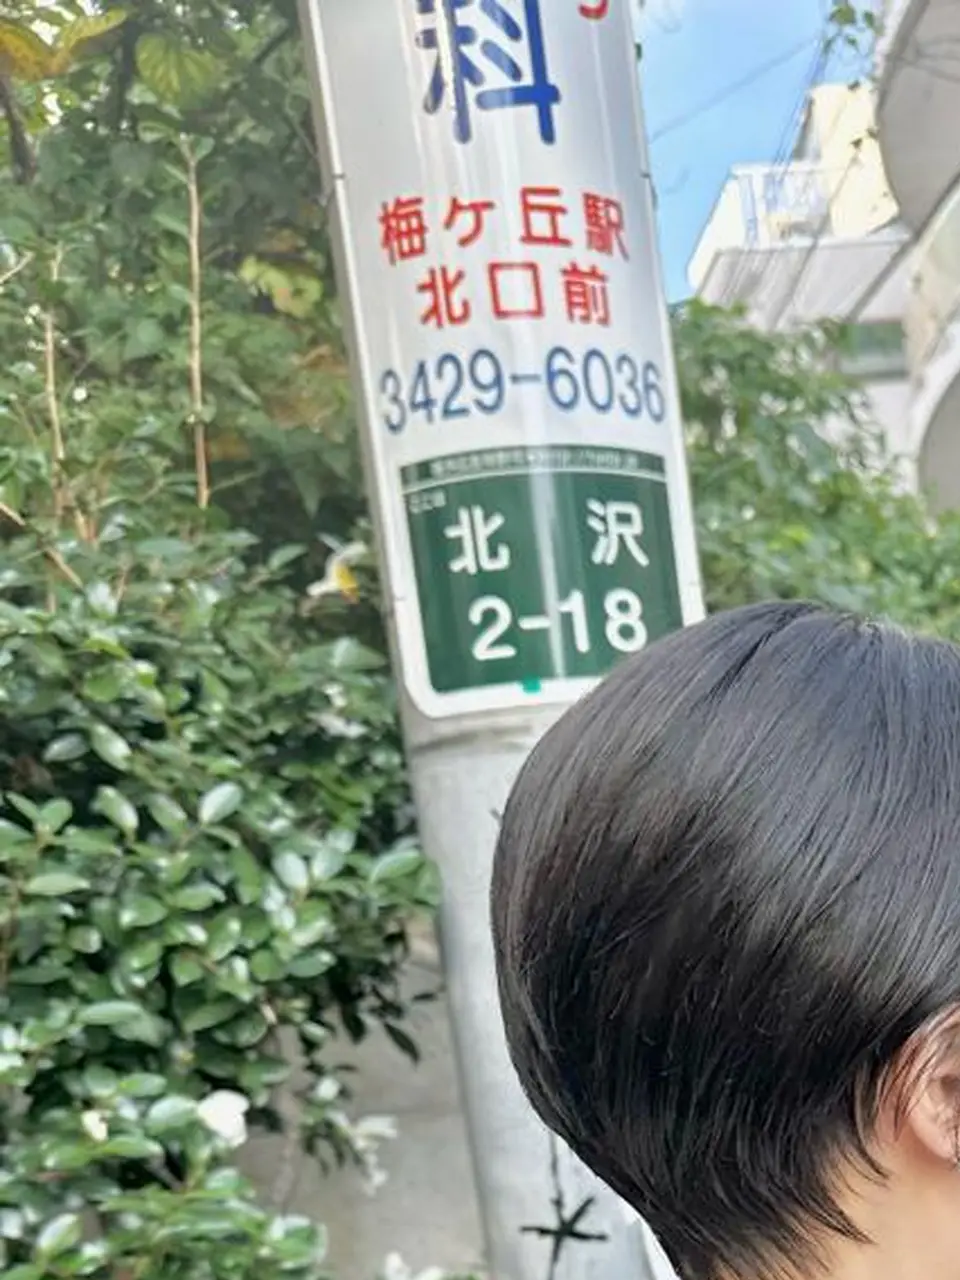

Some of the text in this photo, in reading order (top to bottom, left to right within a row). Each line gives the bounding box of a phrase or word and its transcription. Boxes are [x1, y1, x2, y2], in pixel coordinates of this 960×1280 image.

[416, 262, 612, 329] 北口前
[380, 346, 666, 434] 3429-6036
[444, 498, 650, 575] 北沢
[468, 587, 648, 662] 2-18
